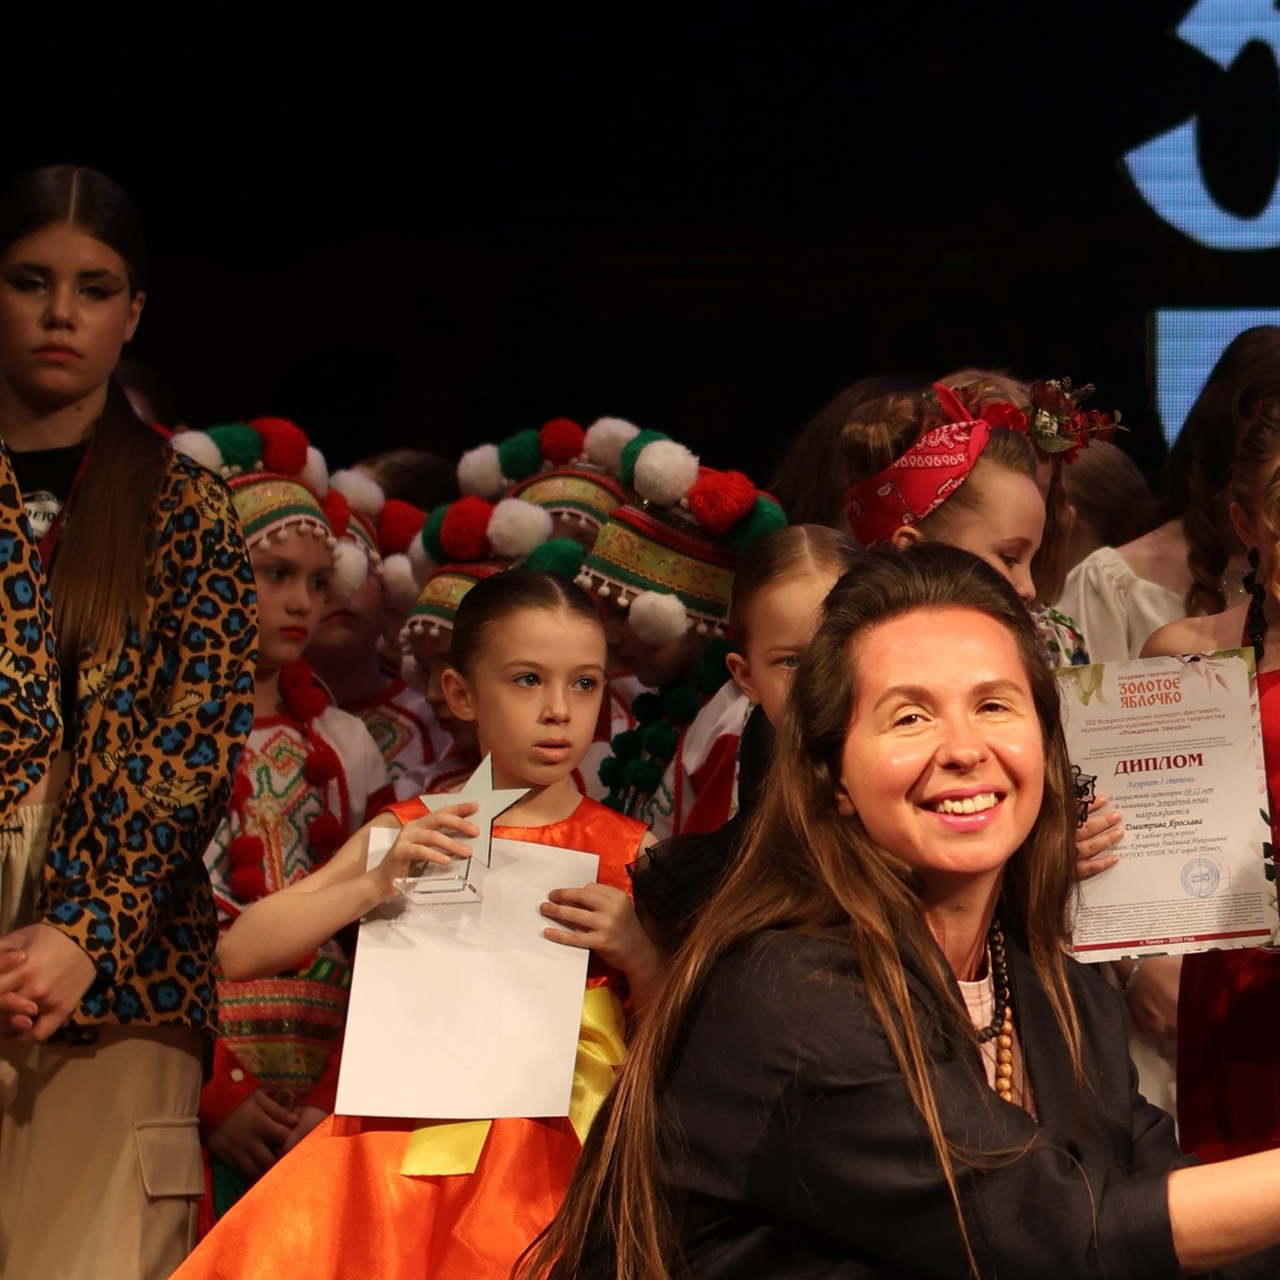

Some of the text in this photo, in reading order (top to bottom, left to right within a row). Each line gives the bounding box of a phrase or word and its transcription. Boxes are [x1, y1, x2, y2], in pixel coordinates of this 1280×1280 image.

[1118, 678, 1181, 696] ЗОЛОТОЕ
[1120, 691, 1182, 709] ЯБЛОЧКО
[1098, 714, 1152, 726] Всероссийский
[1154, 707, 1221, 720] конкурс-фестиваль
[1186, 714, 1226, 723] творчества
[1114, 752, 1204, 777] ДИПЛОМ
[1126, 780, 1158, 790] Лауреат
[1166, 776, 1196, 784] степени
[1136, 808, 1190, 820] награждается
[1166, 818, 1203, 829] Ярослава
